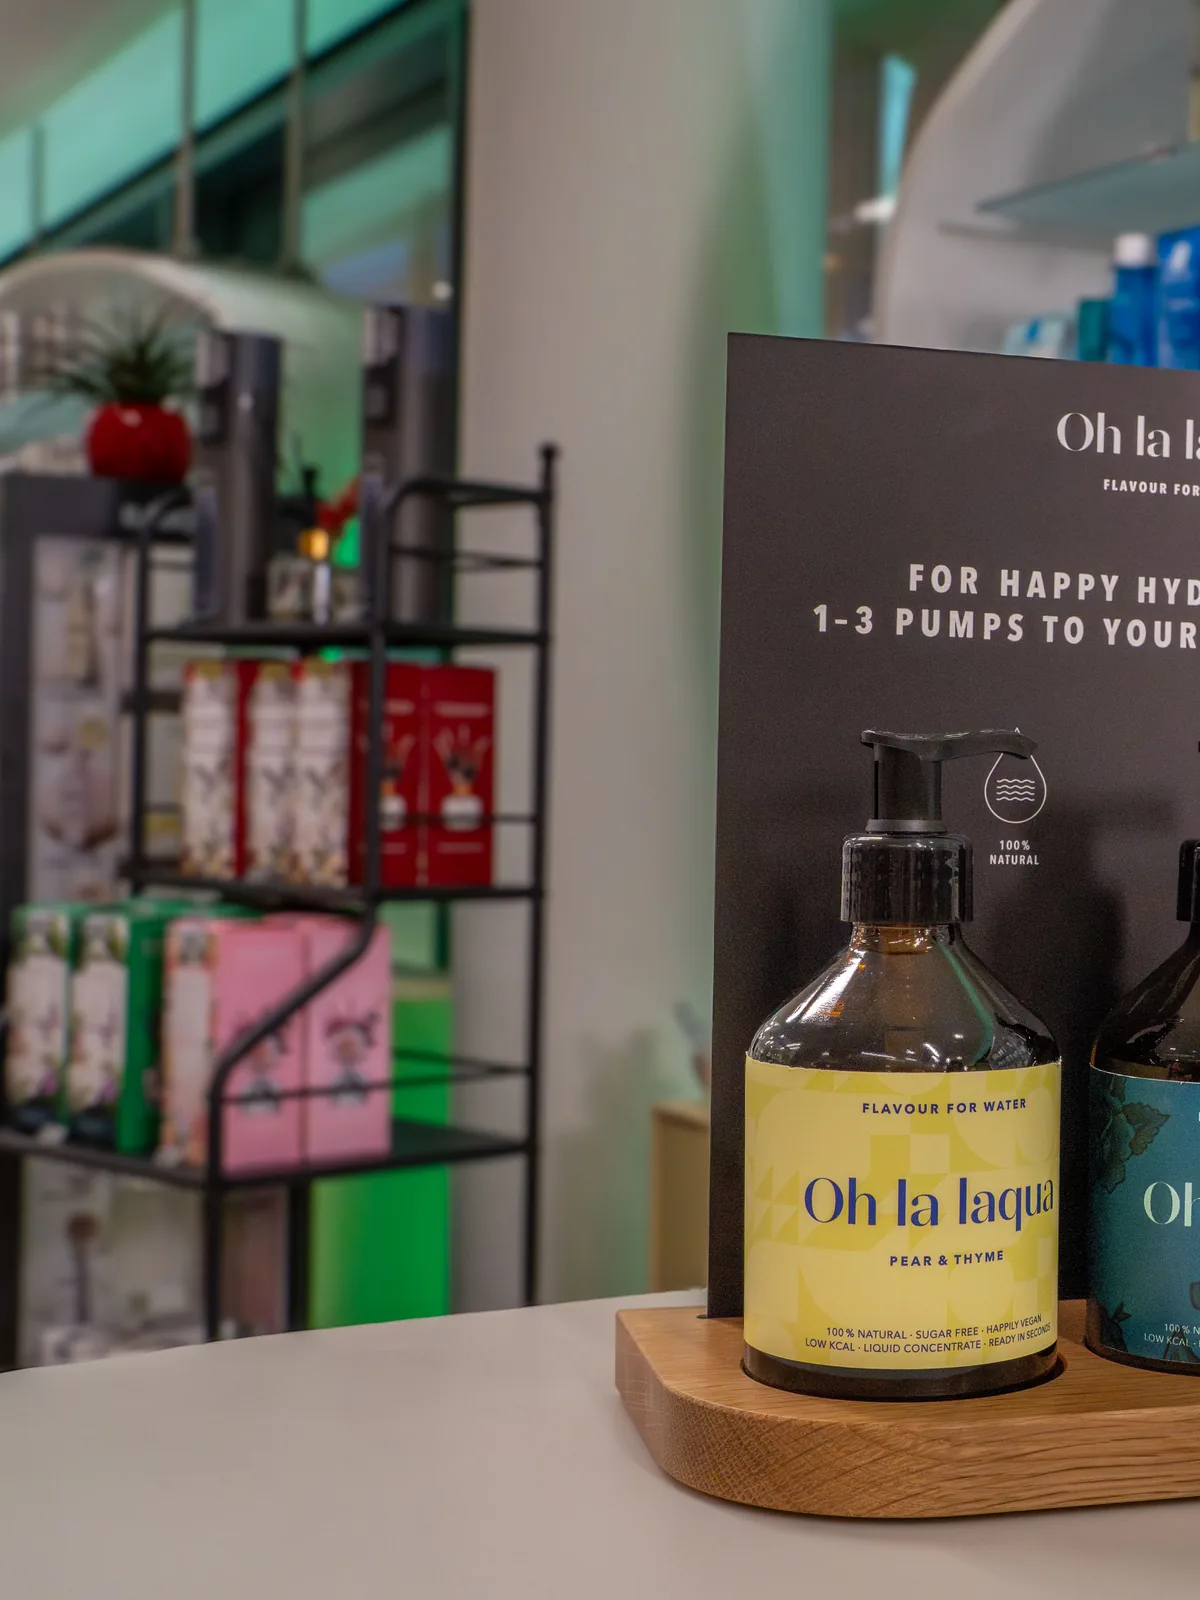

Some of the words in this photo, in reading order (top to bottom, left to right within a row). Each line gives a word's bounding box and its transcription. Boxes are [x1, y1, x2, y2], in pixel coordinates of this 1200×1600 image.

[1056, 412, 1122, 454] Oh
[1136, 415, 1170, 458] la
[1103, 478, 1167, 495] FLAVOUR
[1174, 484, 1200, 497] FOR
[909, 563, 978, 594] FOR
[1000, 569, 1119, 602] HAPPY
[896, 607, 1024, 642] PUMPS
[1042, 615, 1084, 645] TO
[1103, 618, 1196, 649] YOUR
[1000, 840, 1030, 850] 100%
[990, 854, 1040, 866] NATURAL
[862, 1102, 939, 1114] FLAVOUR
[946, 1102, 977, 1114] FOR
[984, 1098, 1026, 1112] WATER
[804, 1177, 877, 1226] Oh
[897, 1178, 939, 1227] la
[958, 1177, 1054, 1232] laqua
[890, 1255, 932, 1267] PEAR
[938, 1255, 948, 1266] &
[954, 1250, 1004, 1265] THYME
[805, 1338, 827, 1348] LOW
[829, 1340, 856, 1352] KCAL
[864, 1344, 900, 1353] LIQUID
[904, 1340, 981, 1353] CONCENTRATE
[988, 1334, 1016, 1347] READY
[1017, 1332, 1025, 1342] IN
[1026, 1322, 1051, 1340] SECONDS
[858, 1330, 908, 1340] NATURAL
[916, 1328, 952, 1340] SUGAR
[955, 1326, 978, 1337] FREE
[986, 1320, 1020, 1334] HAPPILY
[1020, 1314, 1042, 1328] VEGAN
[1144, 1332, 1164, 1343] LOW
[1166, 1336, 1189, 1346] KCAL
